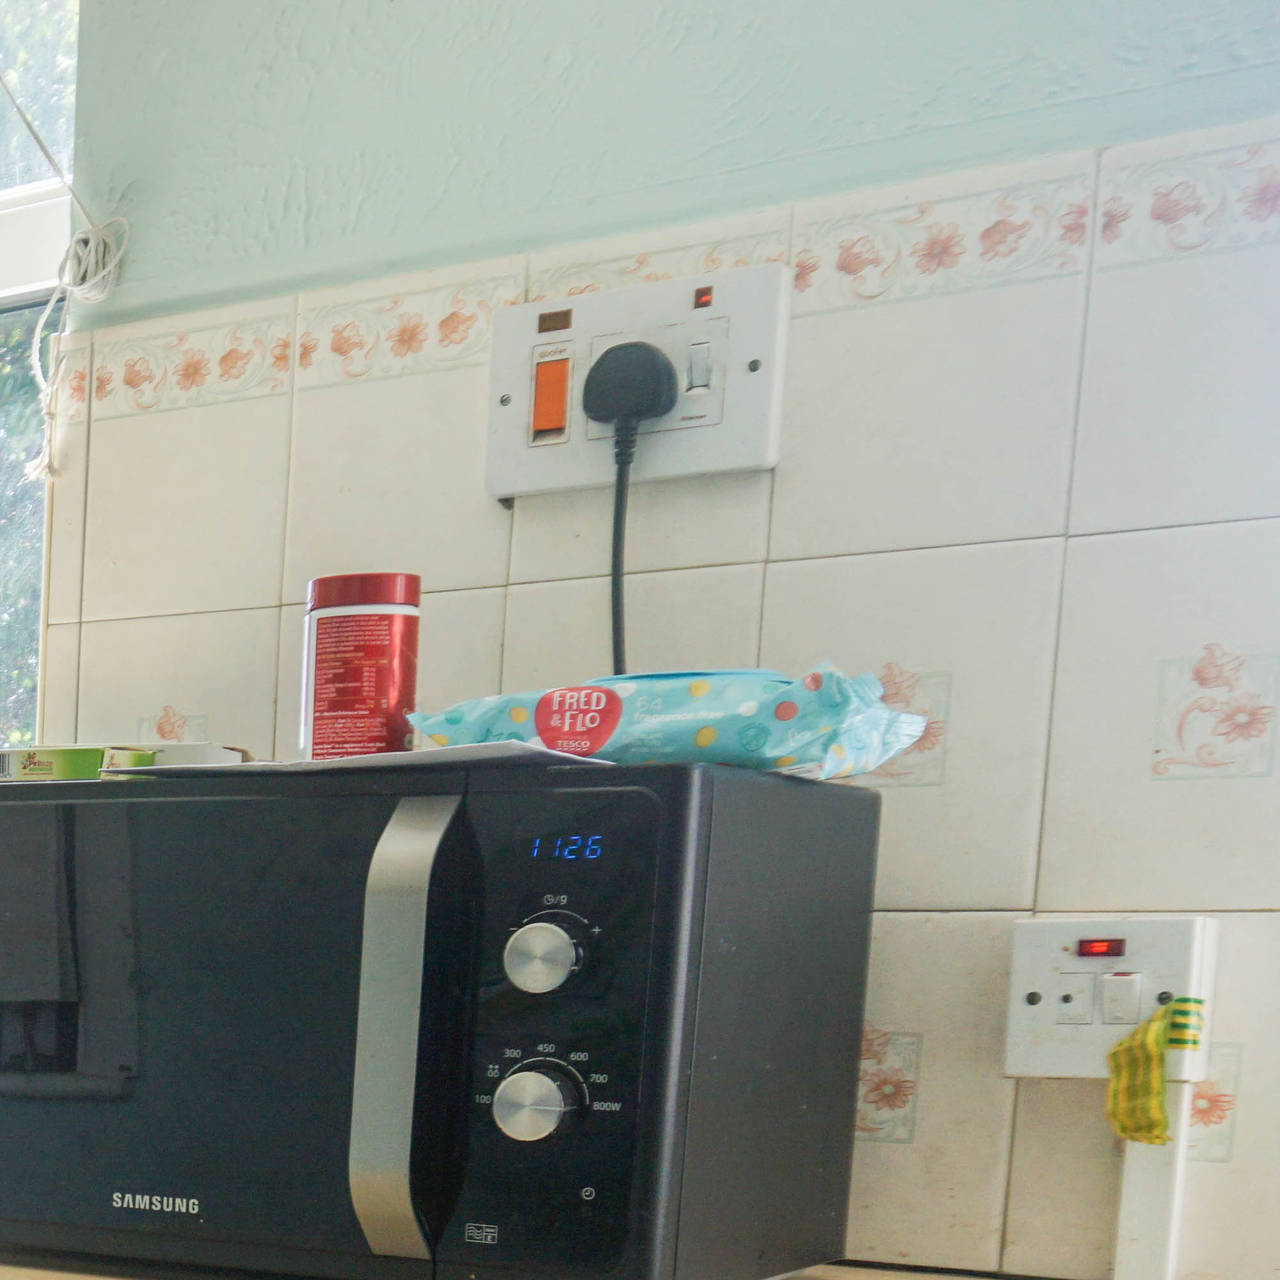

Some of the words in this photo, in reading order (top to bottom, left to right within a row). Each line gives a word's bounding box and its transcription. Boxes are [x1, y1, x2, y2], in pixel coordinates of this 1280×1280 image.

[552, 689, 606, 711] FRED
[550, 714, 562, 727] &
[564, 711, 600, 732] FLO
[556, 740, 590, 748] TESCO
[537, 1043, 556, 1053] 450
[504, 1049, 522, 1058] 300
[570, 1052, 589, 1062] 600
[590, 1073, 608, 1083] 700
[475, 1095, 492, 1104] 100
[593, 1101, 622, 1112] 800W
[112, 1192, 199, 1214] SAMSUNG
